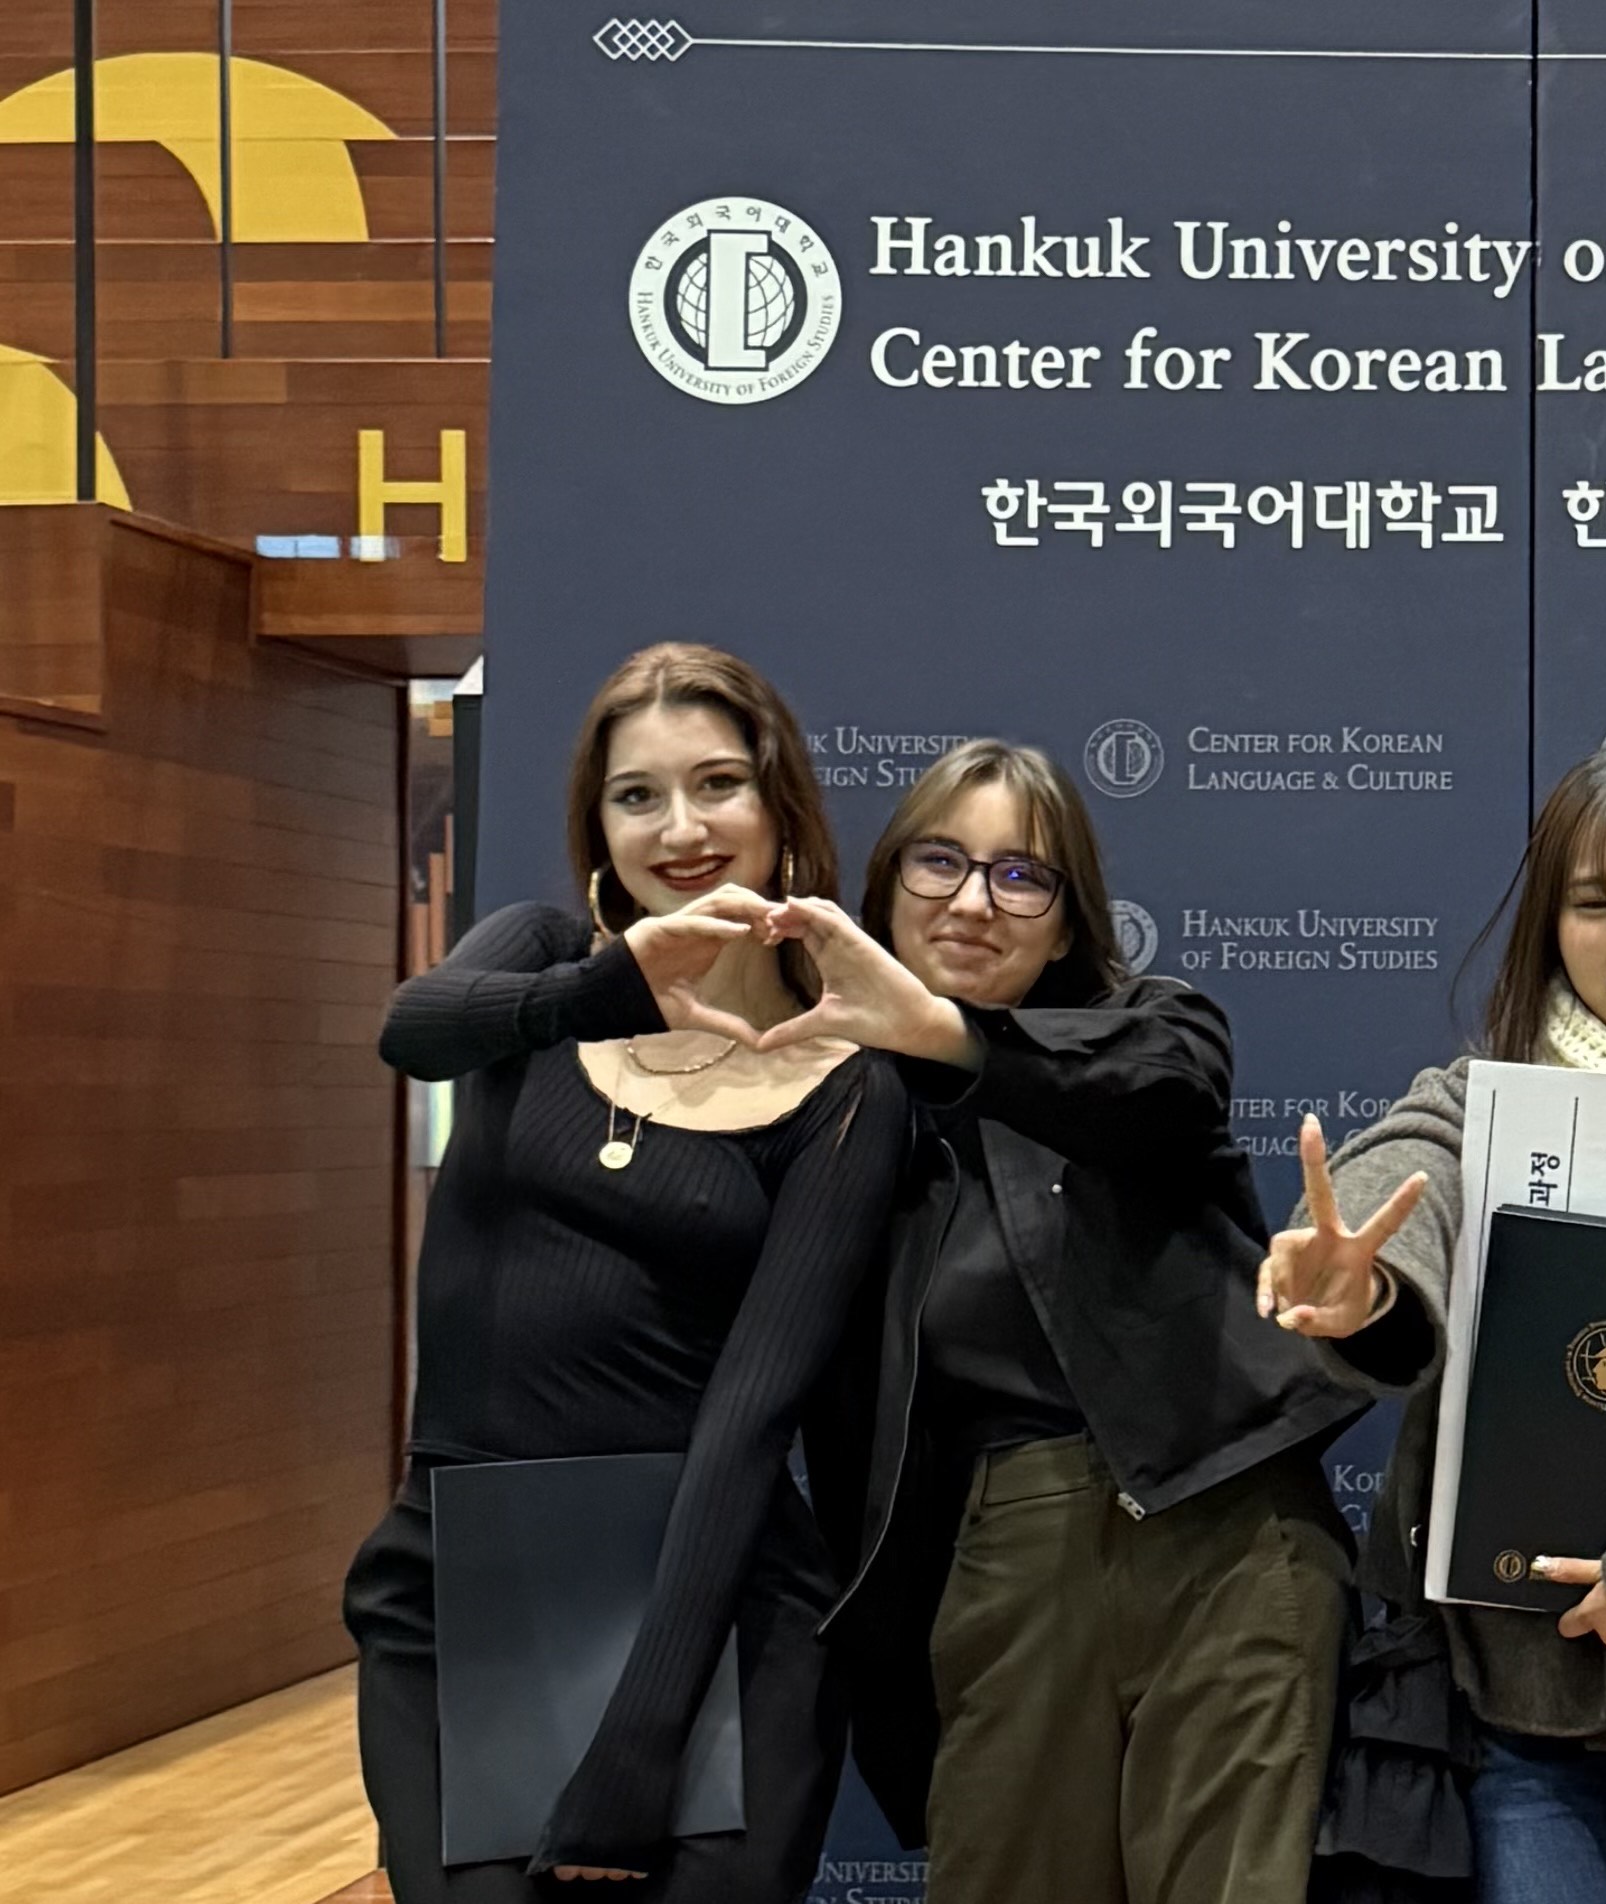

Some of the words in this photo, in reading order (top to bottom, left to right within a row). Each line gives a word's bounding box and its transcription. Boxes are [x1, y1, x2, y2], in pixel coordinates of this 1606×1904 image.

[644, 204, 829, 278] 한국외국어대학교
[868, 215, 1152, 279] Hankuk
[1173, 220, 1532, 298] University
[637, 291, 661, 352] HANKUK
[657, 348, 732, 396] UNIVERSITY
[758, 351, 815, 392] FOREIGN
[807, 294, 834, 351] STUDIES
[869, 326, 1102, 389] Center
[1123, 326, 1232, 391] for
[1252, 332, 1509, 392] Korean
[981, 478, 1504, 550] 한국외국어대학교
[1187, 725, 1280, 754] CENTER
[1287, 733, 1334, 754] FOR
[1340, 725, 1443, 754] KOREAN
[1187, 763, 1316, 791] LANGUAGE
[1321, 771, 1340, 790] &
[1346, 763, 1453, 791] CULTURE
[1181, 909, 1290, 938] HANKUK
[1296, 909, 1439, 938] UNIVERSITY
[1180, 950, 1212, 970] OF
[1220, 941, 1330, 971] FOREIGN
[1337, 941, 1438, 971] STUDIES
[1283, 1098, 1329, 1118] FOR
